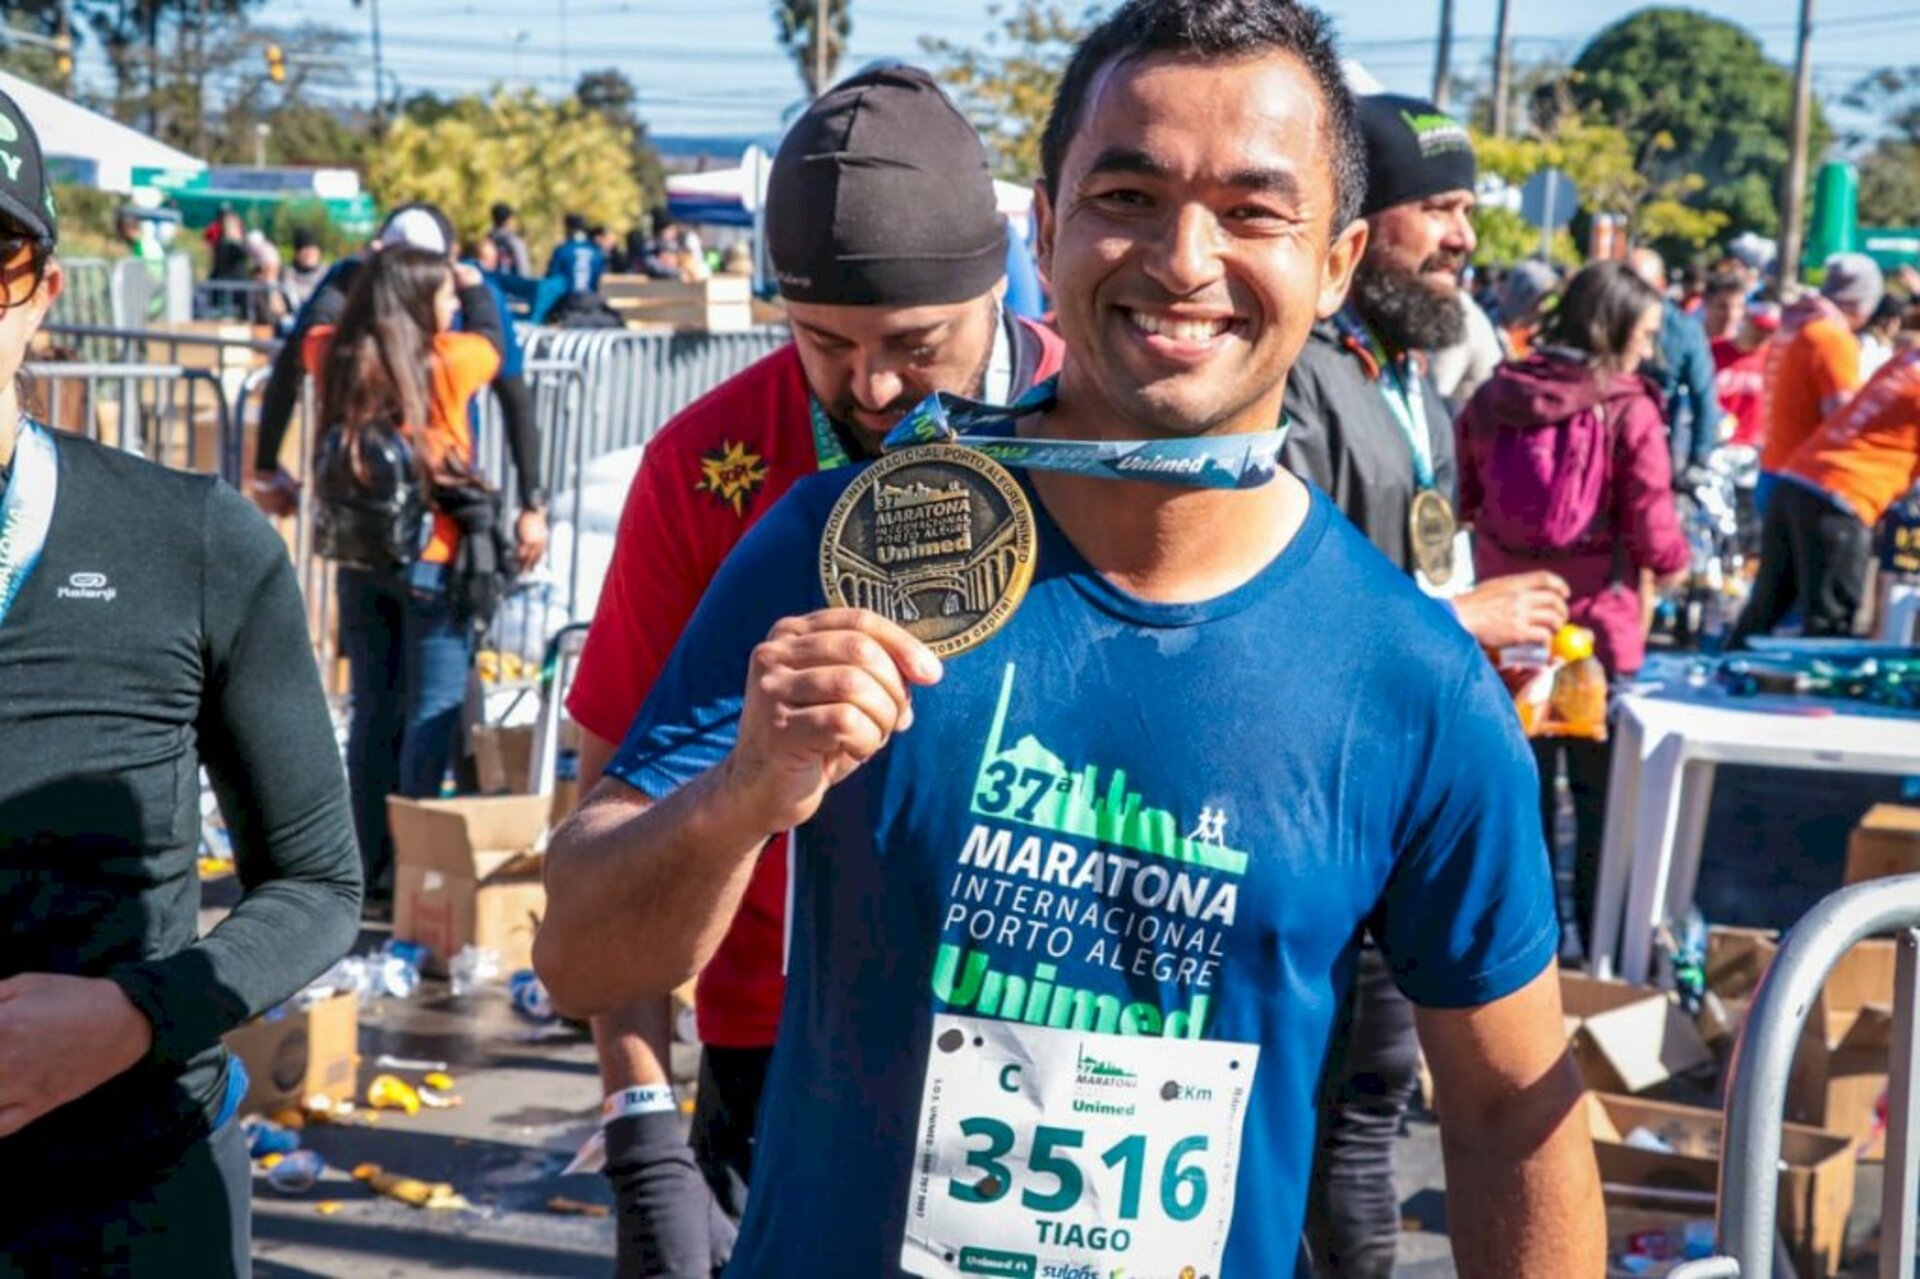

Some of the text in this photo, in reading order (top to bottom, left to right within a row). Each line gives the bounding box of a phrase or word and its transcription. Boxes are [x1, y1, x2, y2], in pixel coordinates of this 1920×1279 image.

[1117, 452, 1210, 474] Unimed
[844, 447, 940, 502] INTERNACIONAL
[943, 447, 985, 469] PORTO
[986, 465, 1020, 509] ALEGRE
[1015, 509, 1030, 564] UNIMED
[876, 498, 971, 526] MARATONA
[877, 531, 972, 564] Unimed
[957, 824, 1239, 927] MARATONA
[950, 871, 1225, 957] INTERNACIONAL
[944, 903, 1221, 987] PORTO ALEGRE
[932, 942, 1211, 1039] Unimed
[999, 1063, 1023, 1093] C
[1076, 1074, 1138, 1088] MARATONA
[1073, 1099, 1136, 1116] Unimed
[947, 1116, 1210, 1222] 3516
[1035, 1218, 1131, 1252] TIAGO
